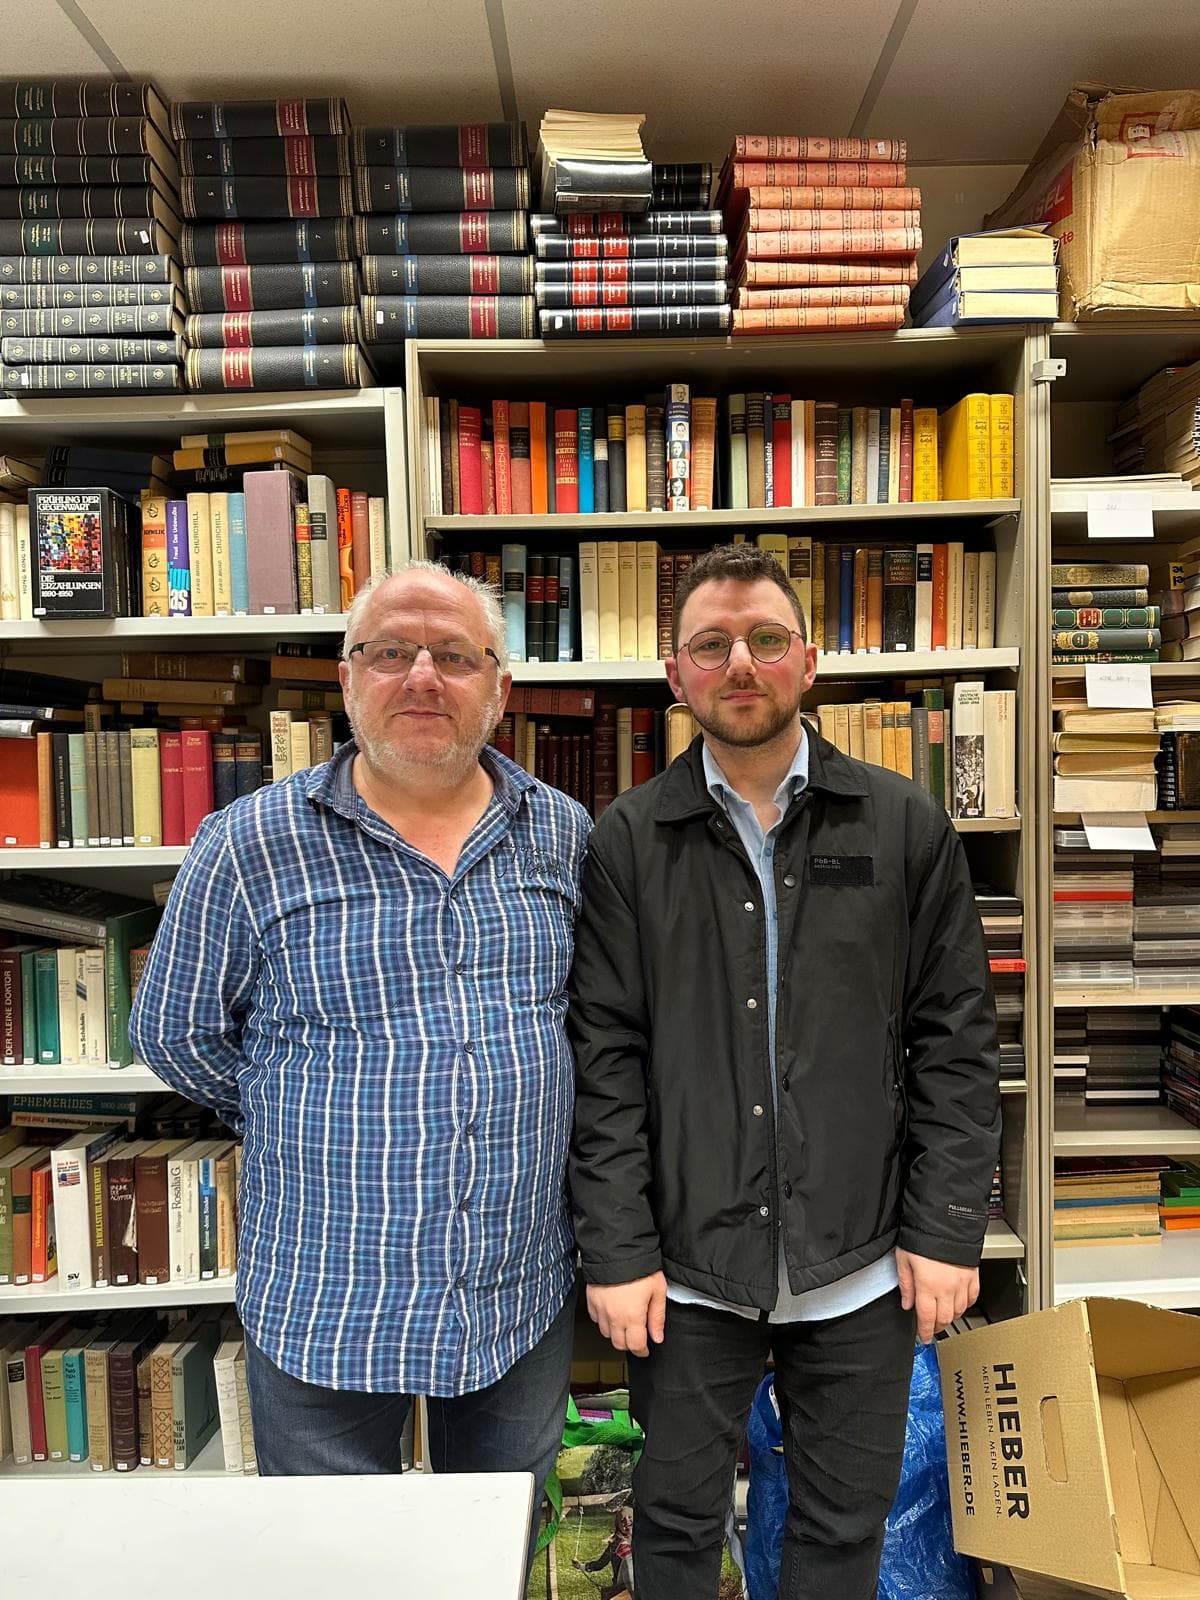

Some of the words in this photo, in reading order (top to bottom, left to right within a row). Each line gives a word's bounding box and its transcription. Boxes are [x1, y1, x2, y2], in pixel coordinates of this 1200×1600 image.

[765, 443, 773, 489] Nationalstolz
[39, 495, 80, 503] FRÜHLING
[13, 1096, 93, 1109] EPHEMERIDES
[172, 1176, 181, 1209] Rosalia
[982, 1366, 990, 1394] MEIN
[986, 1397, 994, 1434] LEBEN.
[954, 1370, 975, 1516] WWW.HIEBER.DE
[989, 1441, 998, 1470] MEIN
[993, 1364, 1030, 1520] HIEBER
[993, 1474, 1002, 1518] LADEN.
